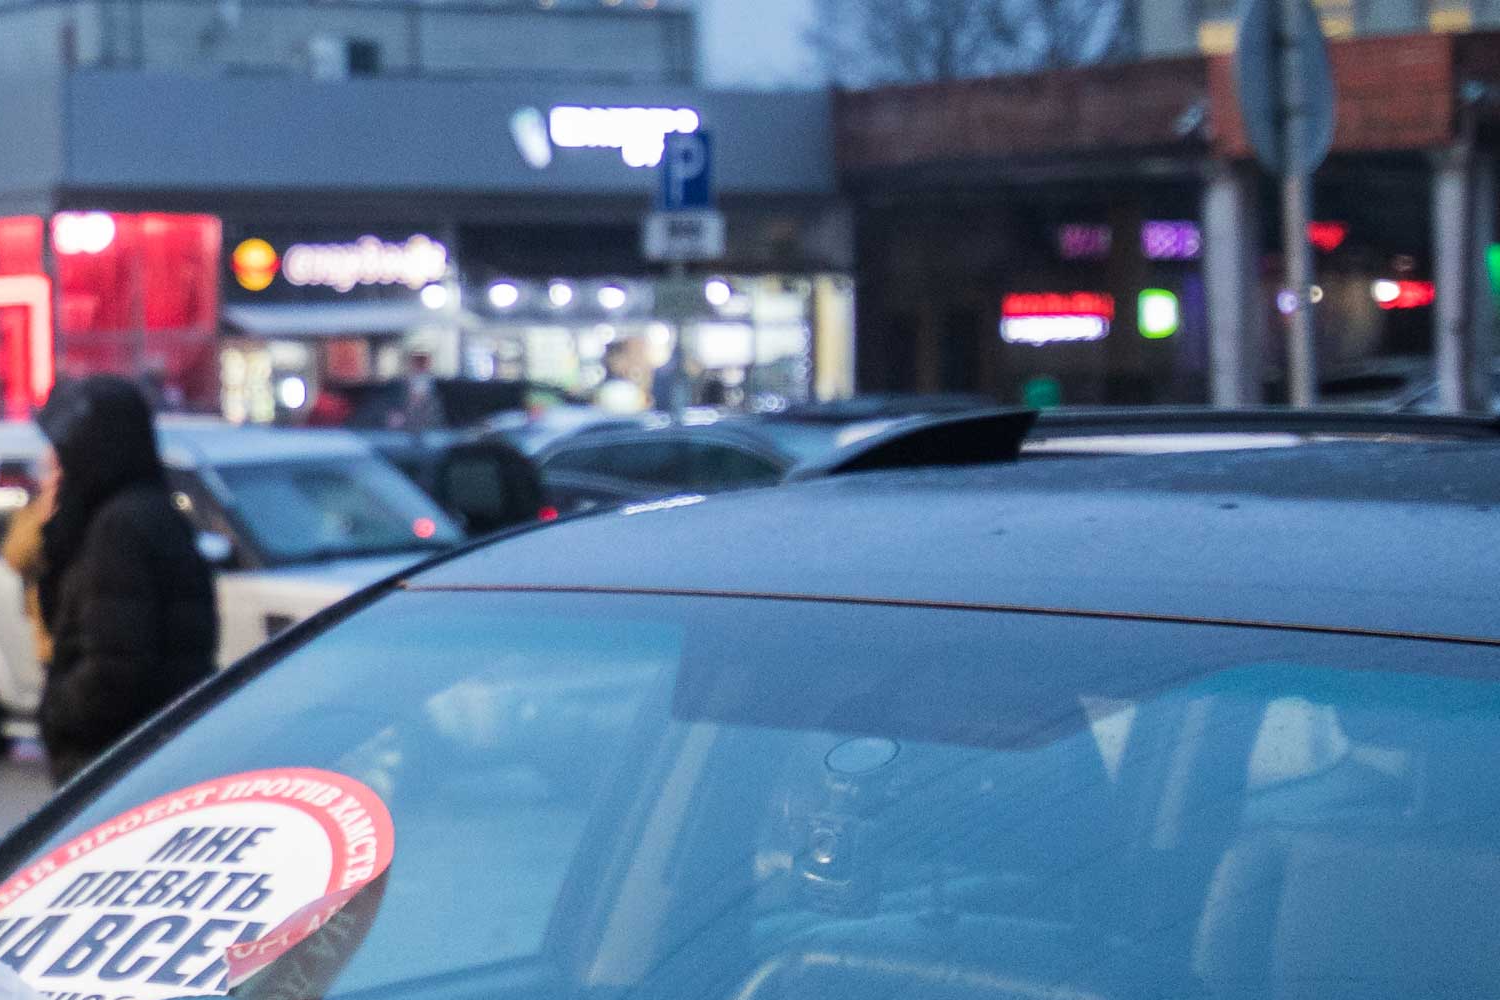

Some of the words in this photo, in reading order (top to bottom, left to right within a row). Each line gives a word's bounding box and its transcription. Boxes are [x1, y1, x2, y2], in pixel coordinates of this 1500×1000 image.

[669, 132, 706, 202] P
[67, 787, 217, 856] ПРОЕКТ
[219, 777, 343, 807] ПРОТИВ
[326, 795, 378, 890] ХАМСТВ
[146, 826, 277, 864] МНЕ
[47, 869, 275, 912] ПЛЕВАТЬ
